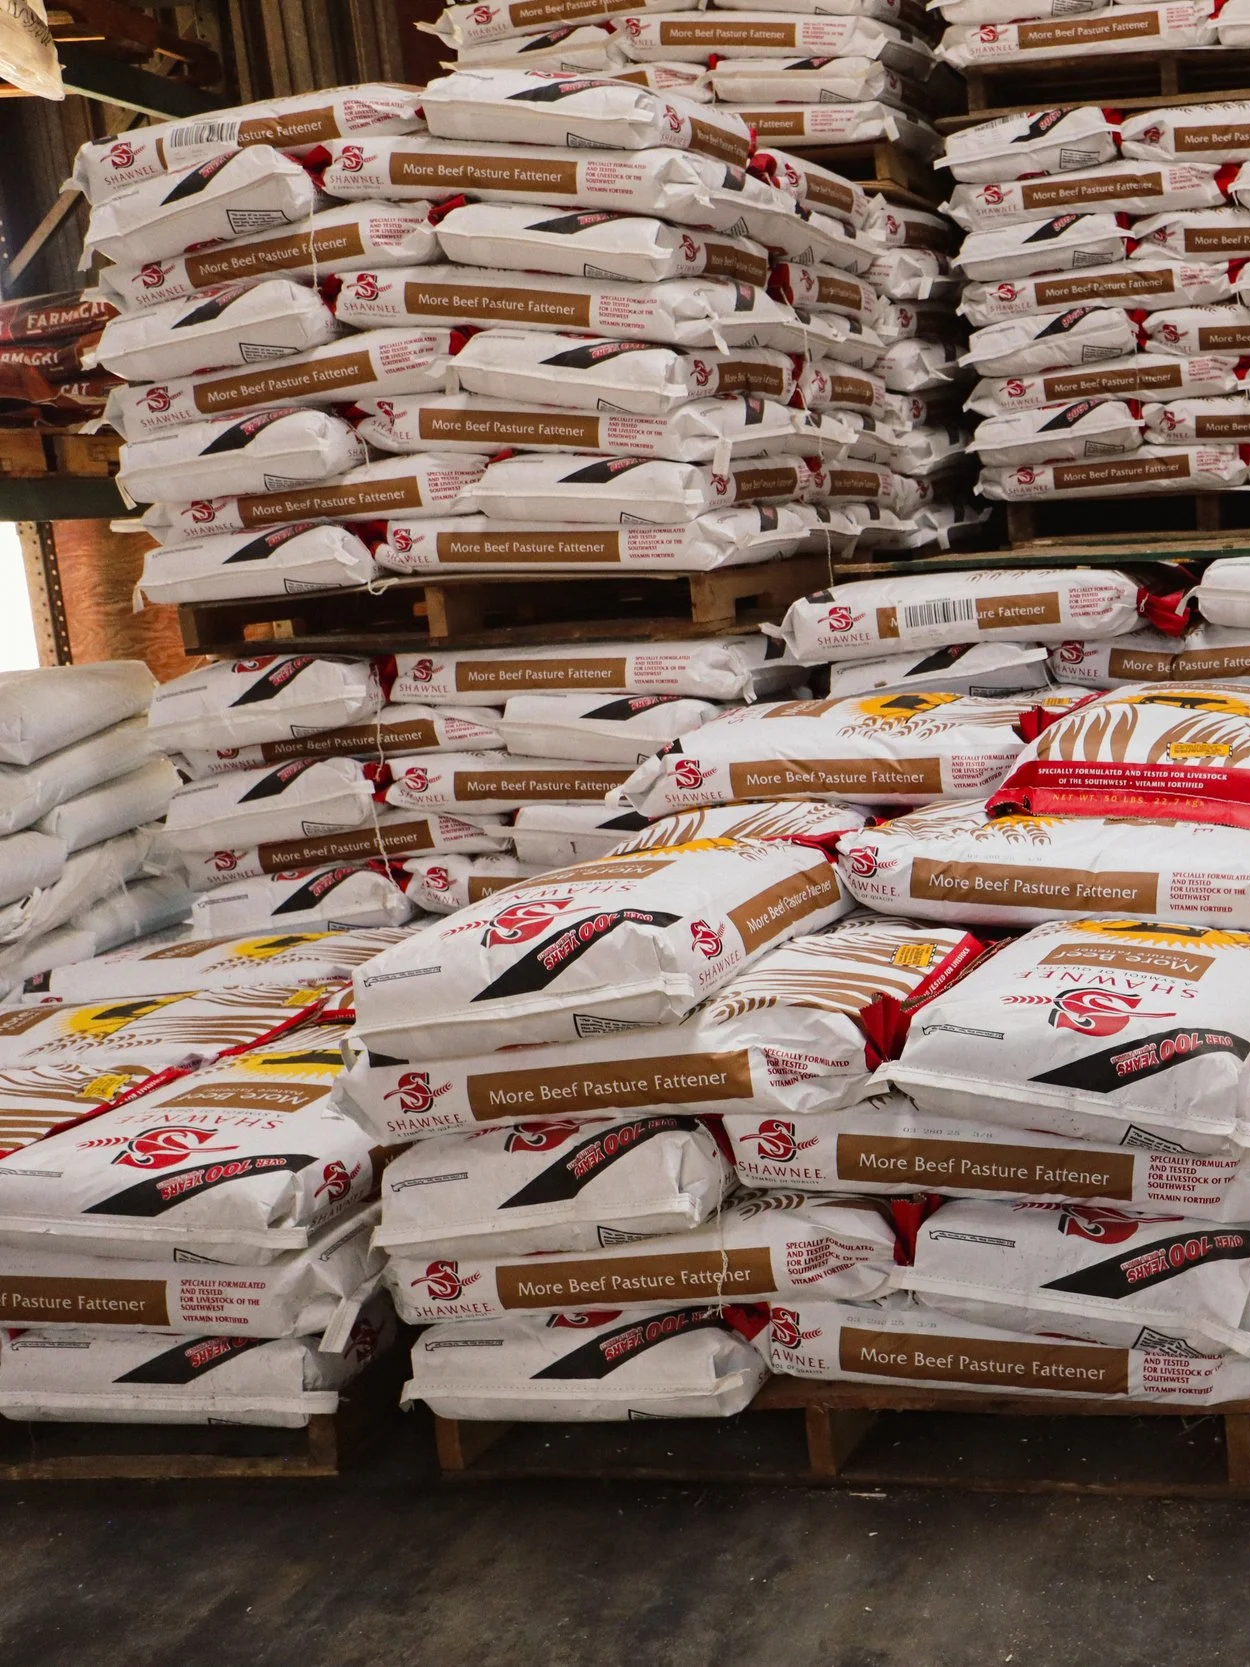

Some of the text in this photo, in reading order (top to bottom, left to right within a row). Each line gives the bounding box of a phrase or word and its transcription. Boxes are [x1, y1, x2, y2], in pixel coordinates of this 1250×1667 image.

[1184, 135, 1209, 143] More
[1211, 133, 1232, 142] Beef
[403, 163, 562, 182] More Beef Pasture Fattener
[330, 175, 385, 185] SHAWNEE
[1209, 335, 1233, 343] More
[207, 366, 359, 403] More Beef Pasture Fattener
[140, 410, 192, 428] SHAWNEE
[1122, 659, 1154, 671] More
[1179, 660, 1220, 671] Pasture
[468, 668, 612, 681] More Beef Pasture Fattener
[747, 771, 924, 785] More Beef Pasture Fattener
[1037, 767, 1228, 780] SPECIALLY FORMULATED AND TESTED FOR LIVESTOCK
[1084, 778, 1128, 786] SOUTHWEST
[1135, 780, 1166, 788] VITAMIN
[1167, 780, 1204, 789] FORTIFIED
[664, 791, 724, 803] SHAWNEE
[1052, 793, 1074, 801] NET
[929, 872, 1138, 899] More Beef Pasture Fattener
[1052, 949, 1199, 973] More Beef
[698, 950, 740, 986] SHAWNEE
[1016, 970, 1199, 1000] SHAWNEE
[1115, 1031, 1234, 1078] OVER 100 YEARS
[489, 1072, 727, 1105] More Beef Pasture Fattener
[386, 1113, 464, 1131] SHAWNEE
[1150, 1155, 1190, 1166] SPECIALLY
[738, 1161, 823, 1179] SHAWNEE
[859, 1153, 1110, 1185] More Beef Pasture Fattener
[1149, 1164, 1197, 1175] AND TESTED
[159, 1157, 288, 1201] OVER 100 YEARS
[1148, 1172, 1164, 1181] FOR
[1166, 1173, 1209, 1185] LIVESTOCK
[1147, 1181, 1196, 1192] SOUTHWEST
[1147, 1192, 1221, 1205] VITAMIN FORTIFIED
[180, 1279, 266, 1290] SPECIALLY FORMULATED
[518, 1270, 751, 1296] More Beef Pasture Fattener
[198, 1288, 223, 1296] TESTED
[12, 1293, 146, 1311] Pasture Fattener
[180, 1303, 225, 1312] SOUTHWEST
[196, 1296, 235, 1304] LIVESTOCK
[247, 1298, 260, 1306] THE
[414, 1302, 495, 1317] SHAWNEE
[182, 1315, 249, 1325] VITAMIN FORTIFIED
[861, 1347, 1106, 1380] More Beef Pasture Fattener
